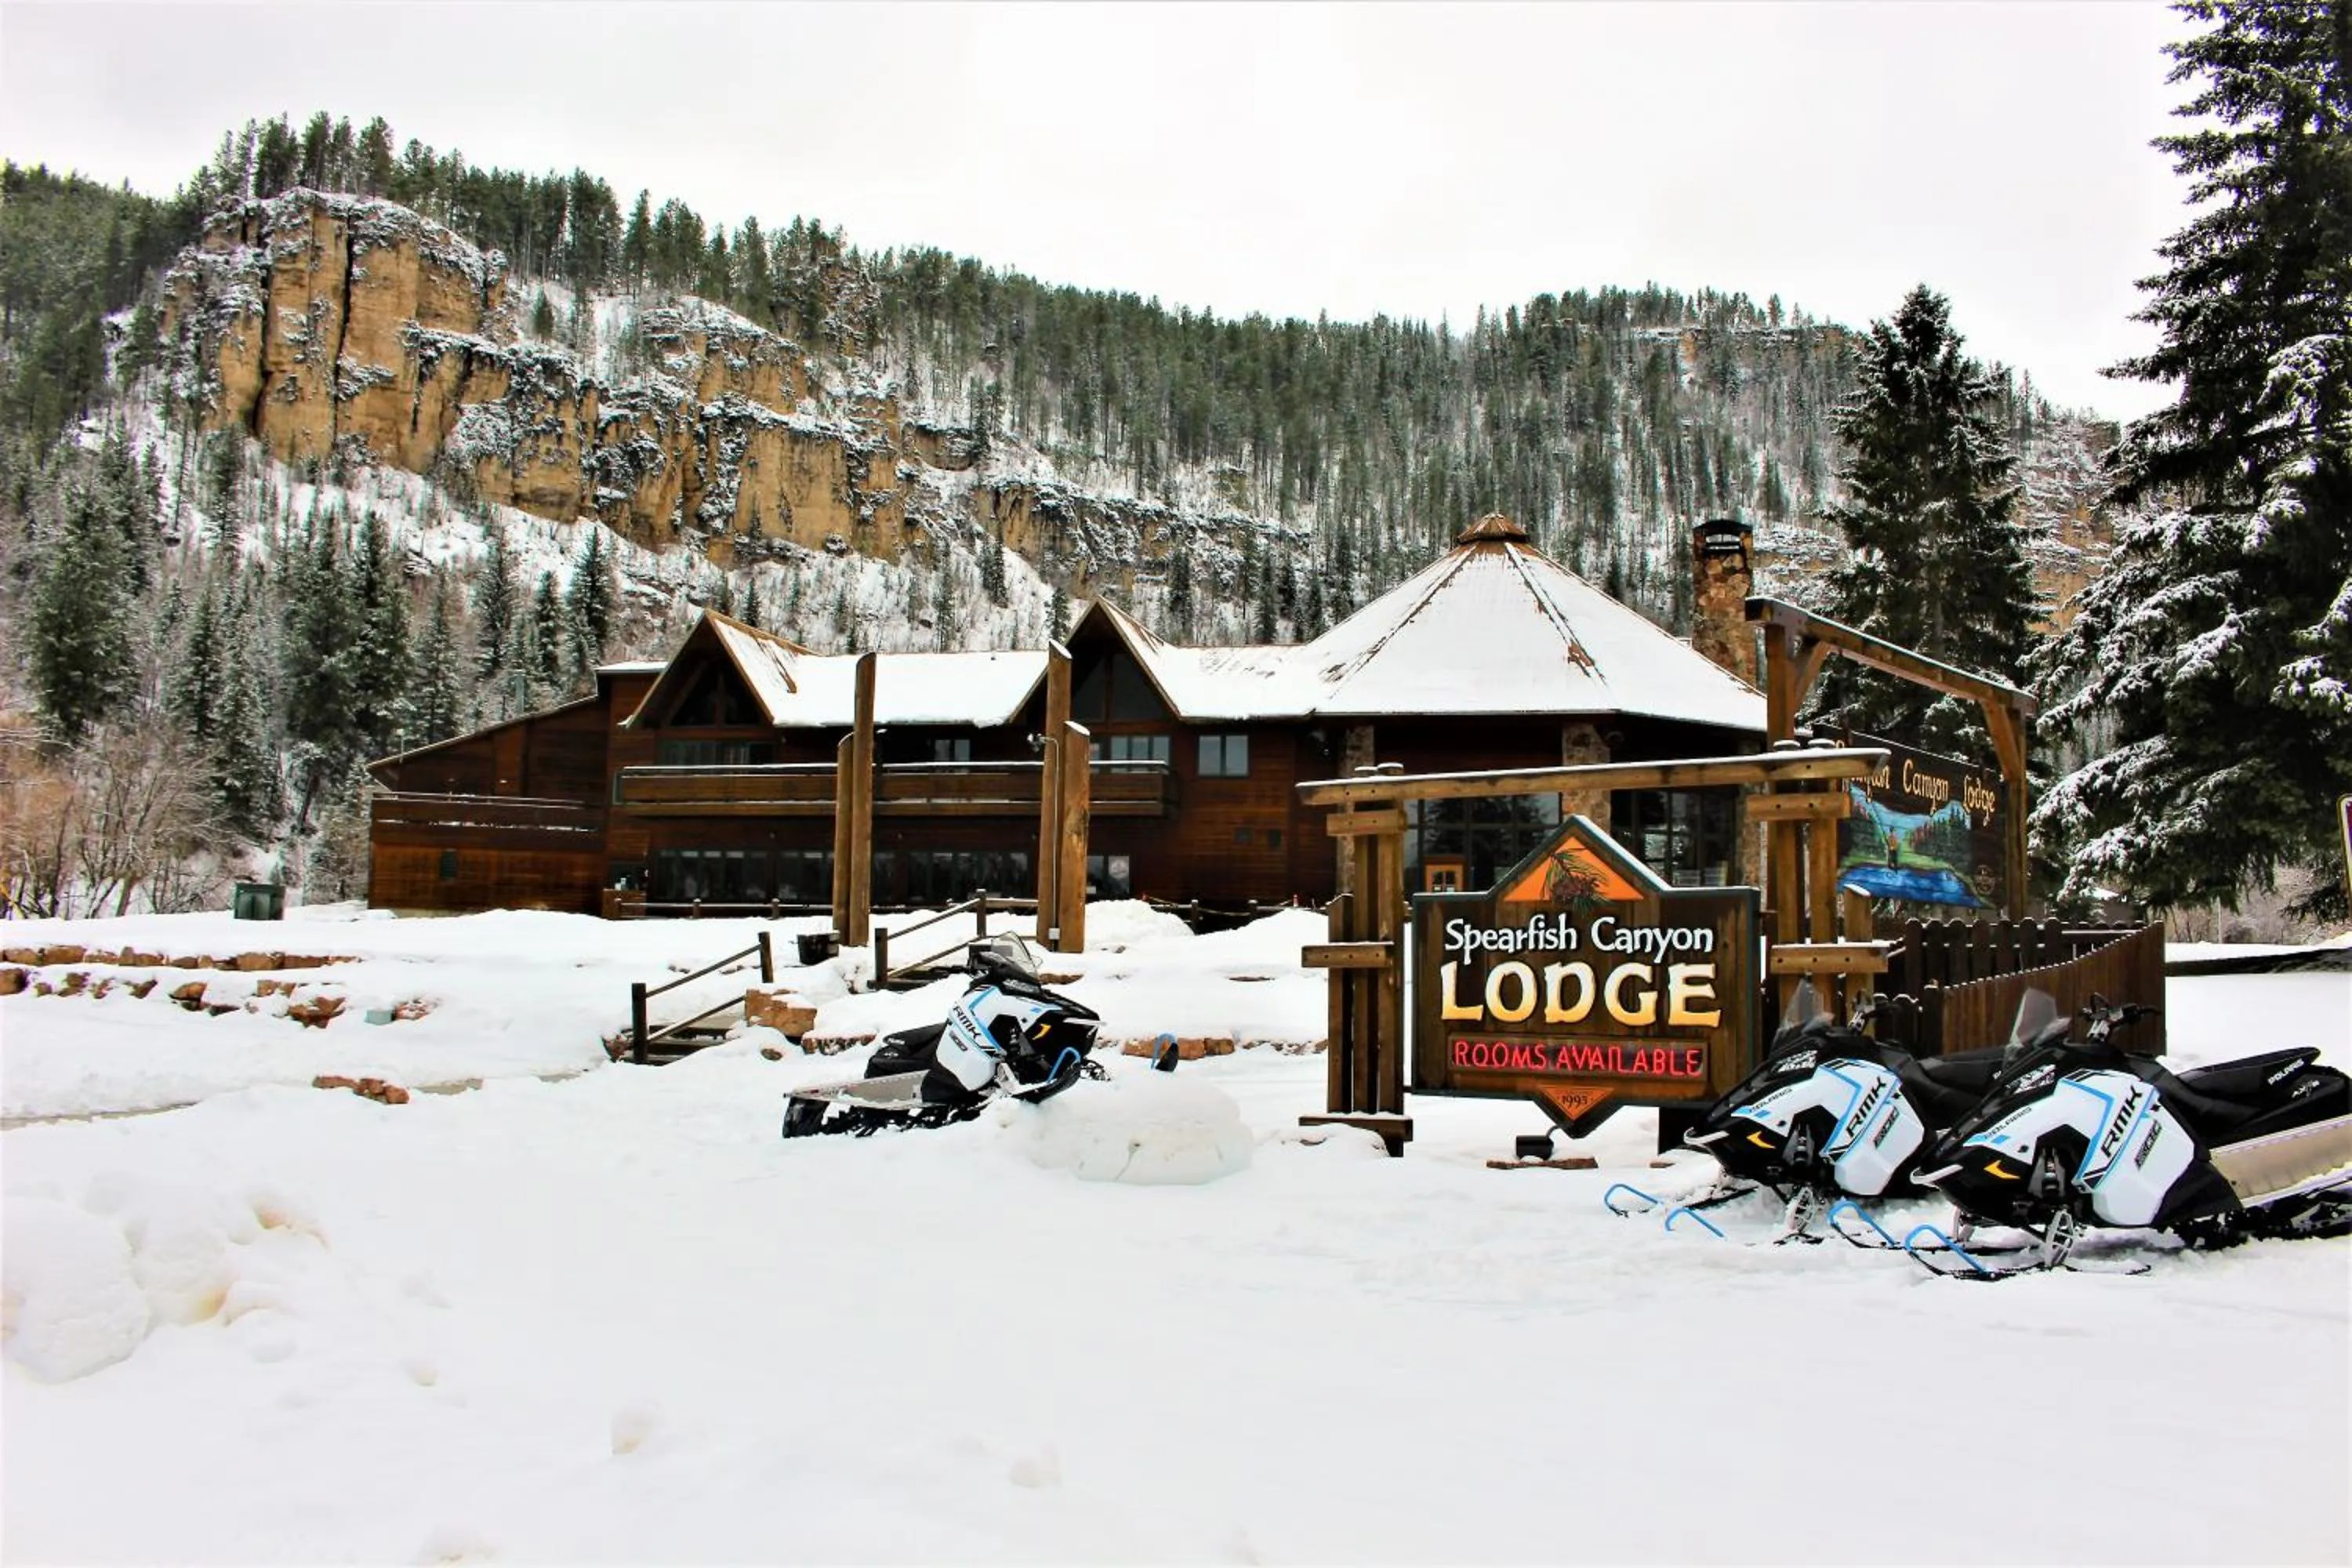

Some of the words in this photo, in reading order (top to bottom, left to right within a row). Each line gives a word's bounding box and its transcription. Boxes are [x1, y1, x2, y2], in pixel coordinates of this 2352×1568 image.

[1903, 758, 1950, 816] Canyon
[1962, 775, 1996, 827] Lodge
[1444, 913, 1577, 965] Spearfish
[1591, 916, 1715, 963] Canyon
[1439, 960, 1722, 1028] LODGE
[1453, 1041, 1548, 1069] ROOMS
[1555, 1045, 1704, 1077] AVAILABLE
[2267, 1058, 2304, 1085] POLARIS
[1846, 1076, 1887, 1138] RMK
[2101, 1085, 2143, 1158] RMK
